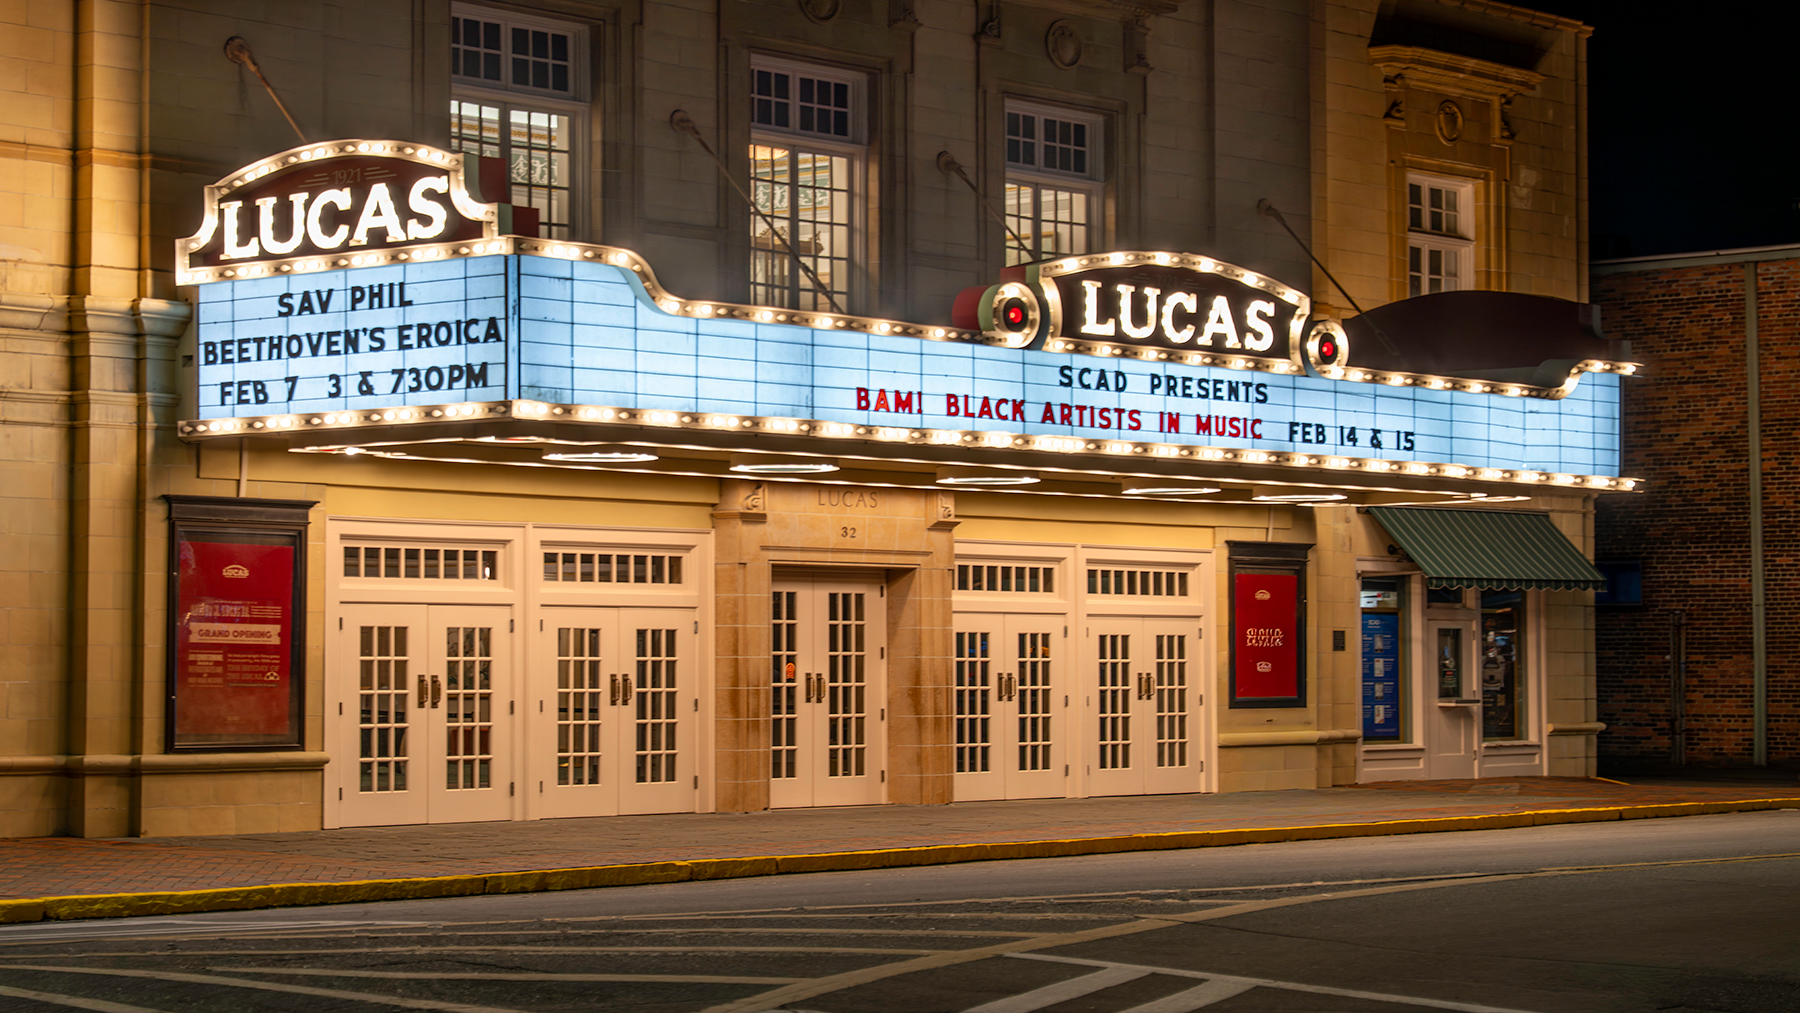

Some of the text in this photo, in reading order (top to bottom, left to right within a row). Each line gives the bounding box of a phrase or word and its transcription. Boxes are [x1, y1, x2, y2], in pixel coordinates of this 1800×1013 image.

[332, 168, 361, 184] 1921
[219, 176, 448, 260] LUCAS
[278, 282, 413, 317] SAV PHIL
[1155, 274, 1179, 289] 1921
[1081, 280, 1275, 352] LUCAS
[203, 317, 502, 365] BEETHOVEN'S EROICA
[219, 362, 488, 406] FEB 7 3 & 730PM
[1059, 366, 1268, 404] SCAD PRESENTS
[857, 387, 1415, 451] BAM! BLACK ARTISTS IN MUSIC FEB 14 & 15
[818, 489, 878, 508] LUCAS
[841, 526, 856, 538] 32
[198, 629, 272, 638] GRAND OPENING
